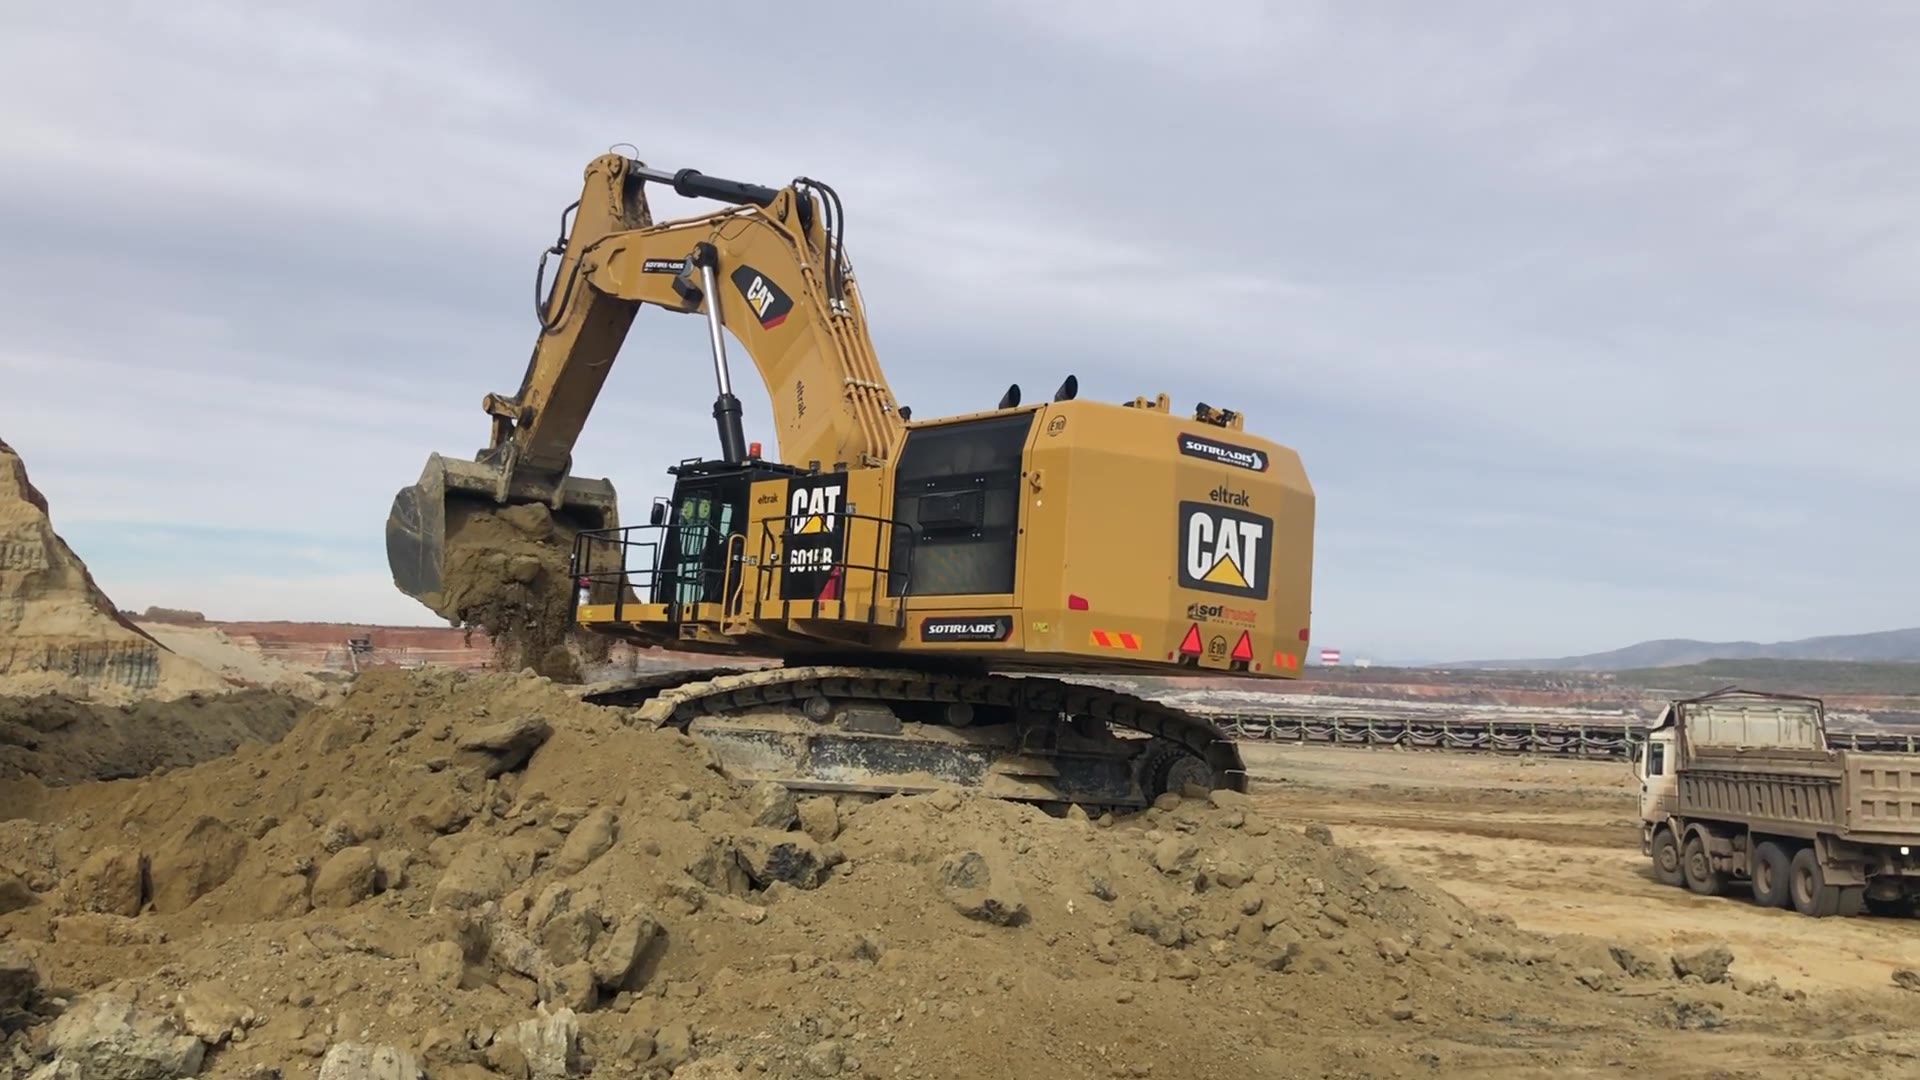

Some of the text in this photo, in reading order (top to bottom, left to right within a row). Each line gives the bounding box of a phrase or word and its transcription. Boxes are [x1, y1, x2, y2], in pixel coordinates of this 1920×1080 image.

[747, 276, 775, 318] CAT
[1185, 441, 1253, 463] SOTIRIADIS
[757, 493, 778, 505] eltrak
[1209, 485, 1250, 507] eltrak
[791, 485, 841, 534] CAT
[1187, 511, 1263, 589] CAT
[928, 623, 996, 634] SOTIRIADIS
